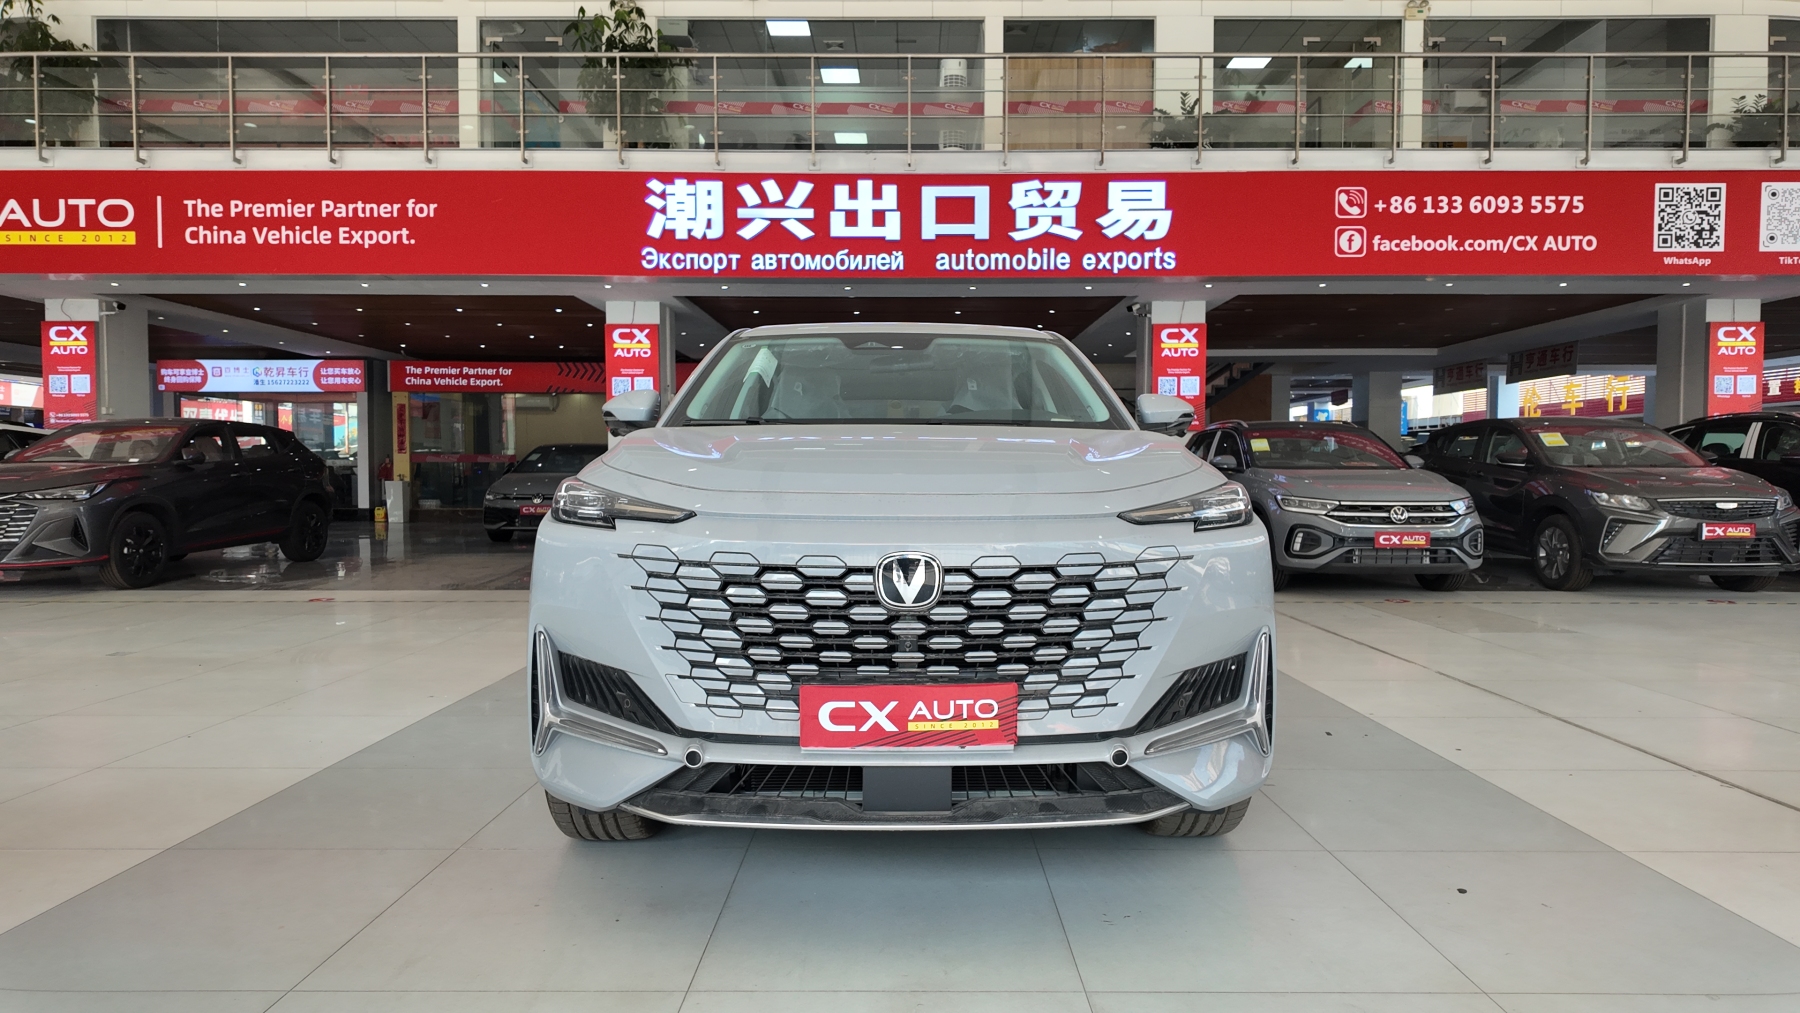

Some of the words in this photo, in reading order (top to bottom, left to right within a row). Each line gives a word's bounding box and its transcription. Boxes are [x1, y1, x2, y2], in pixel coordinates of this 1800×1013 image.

[184, 199, 223, 218] The
[231, 199, 315, 218] Premier
[322, 200, 401, 218] Partner
[406, 199, 438, 218] for
[645, 179, 1173, 241] 潮兴出口贸易
[1374, 196, 1416, 213] +86
[1424, 196, 1462, 213] 133
[1470, 196, 1523, 213] 6093
[1531, 196, 1584, 213] 5575
[0, 199, 134, 228] AUTO
[5, 234, 64, 242] SINCE
[81, 234, 127, 242] 2012
[185, 226, 245, 245] China
[253, 226, 331, 245] Vehicle
[339, 227, 416, 249] Export.
[1373, 235, 1538, 253] facebook.com/CX
[1543, 236, 1597, 252] AUTO
[642, 247, 741, 274] Экспорт
[751, 249, 904, 271] автомобилей
[935, 247, 1071, 271] automobile
[1082, 247, 1176, 274] exports
[1664, 257, 1711, 266] WhatsApp
[49, 326, 87, 341] CX
[613, 328, 650, 344] CX
[1161, 328, 1199, 343] CX
[1718, 326, 1757, 341] CX
[50, 346, 88, 355] AUTO
[614, 348, 652, 358] AUTO
[1161, 348, 1199, 357] AUTO
[1718, 346, 1756, 355] AUTO
[405, 366, 422, 375] The
[425, 366, 460, 375] Premier
[463, 367, 497, 376] Partner
[499, 367, 513, 376] for
[320, 377, 362, 385] 让您用车安心
[405, 377, 431, 386] China
[434, 377, 467, 386] Vehicle
[470, 378, 503, 388] Export.
[1705, 527, 1725, 536] CX
[1379, 535, 1401, 545] CX
[1402, 535, 1426, 543] AUTO
[818, 701, 899, 732] CX
[908, 699, 999, 721] AUTO
